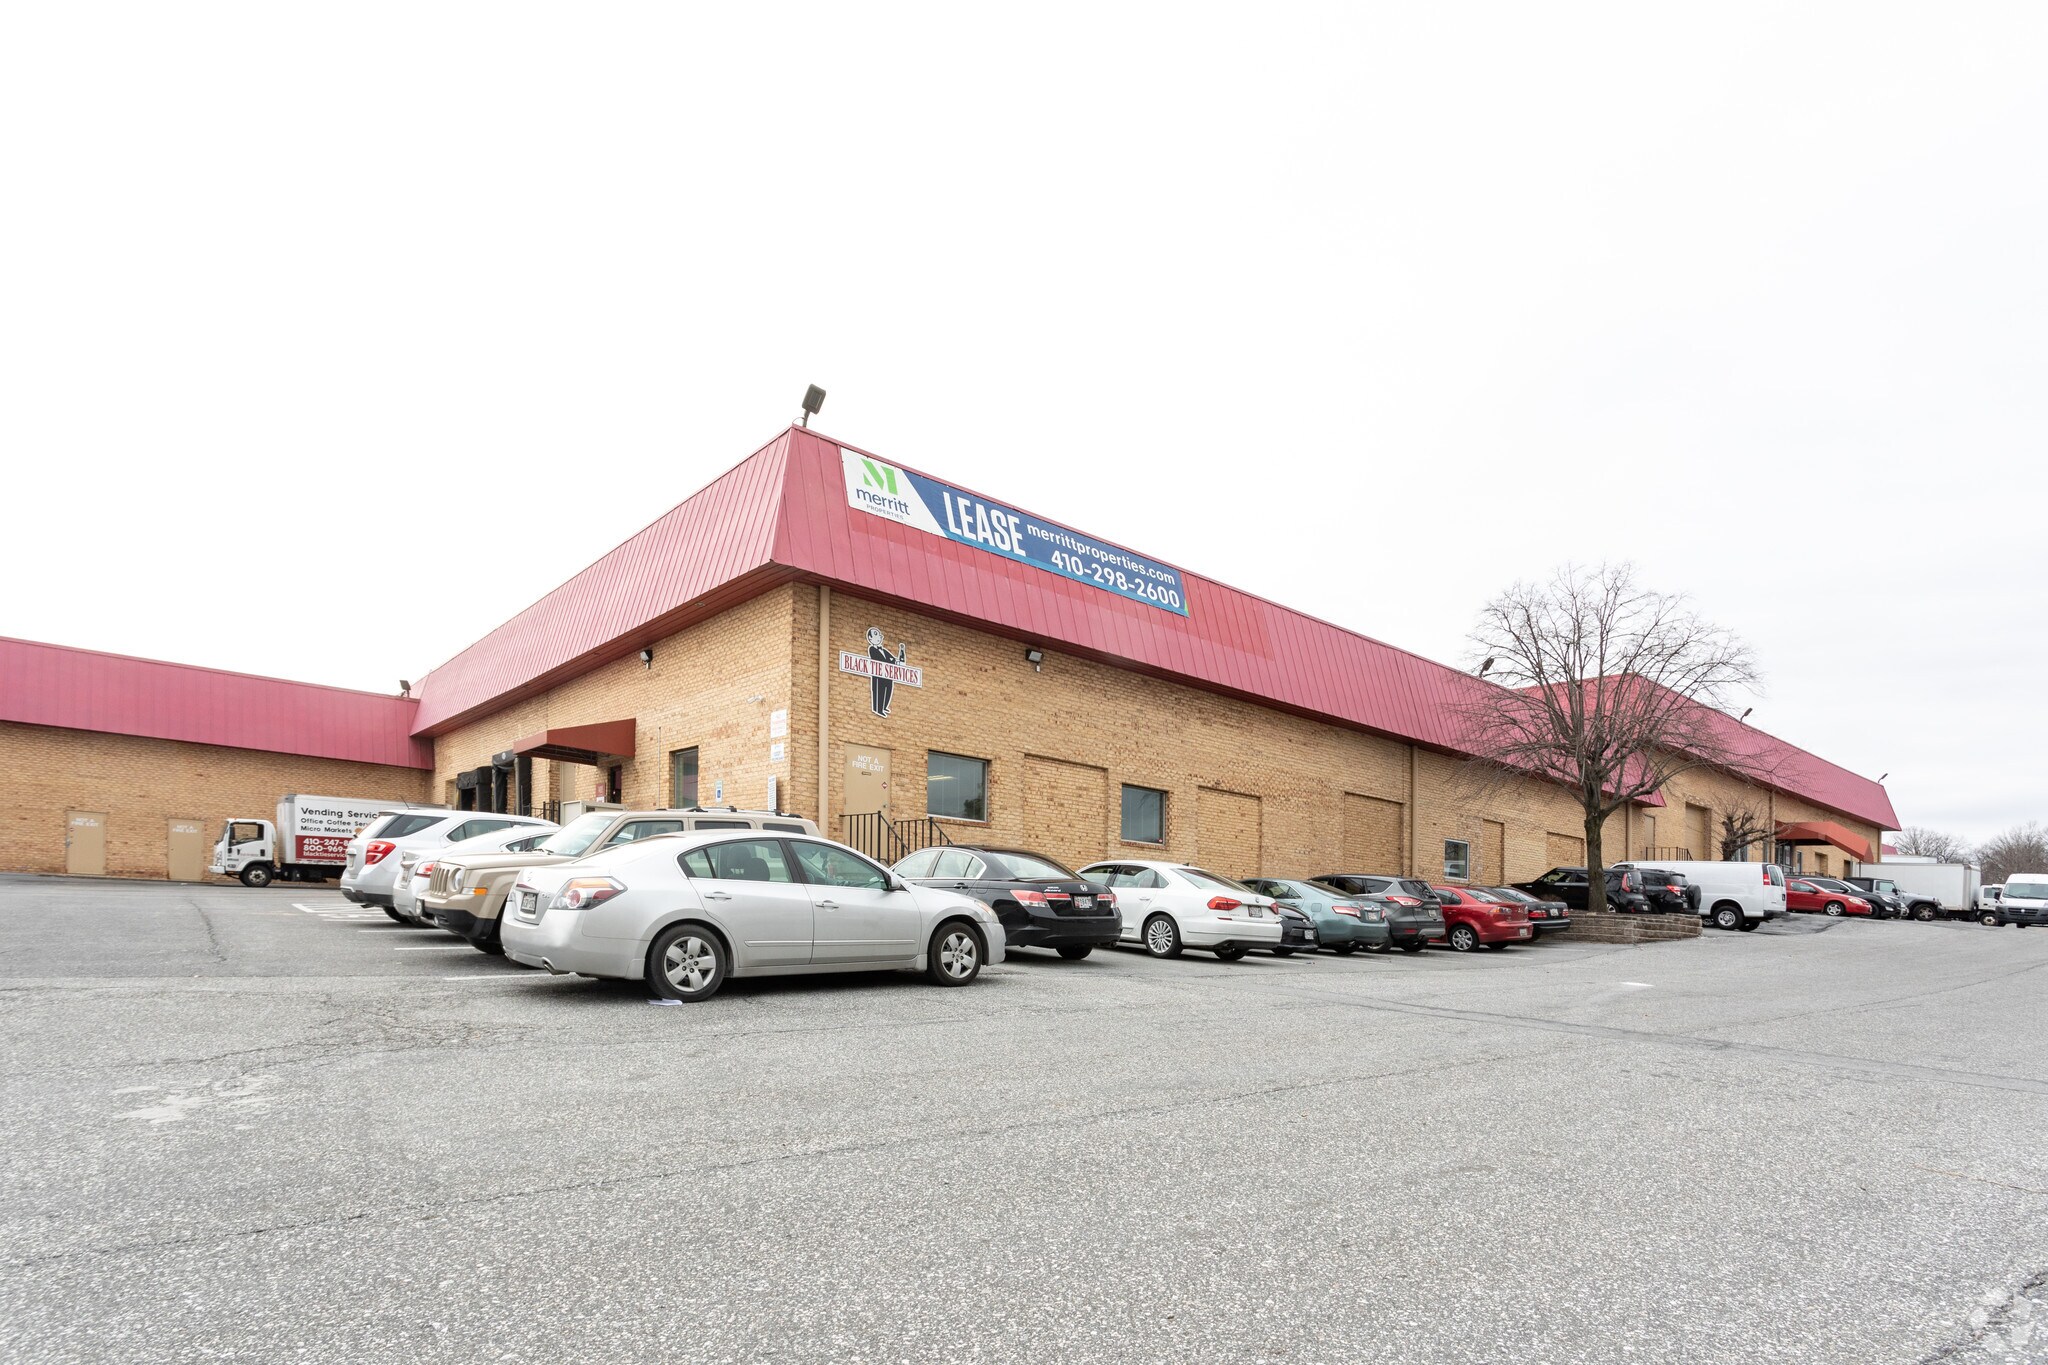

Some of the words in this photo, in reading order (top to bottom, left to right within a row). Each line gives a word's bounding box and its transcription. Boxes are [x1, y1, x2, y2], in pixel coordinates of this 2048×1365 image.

[856, 488, 910, 516] merritt
[866, 503, 904, 520] PROPERTIES
[943, 491, 1026, 557] LEASE
[1026, 523, 1176, 586] merrittproperties.com
[1051, 550, 1180, 608] 410-298-2600
[844, 655, 869, 674] BLACK
[870, 661, 883, 677] TIE
[884, 663, 918, 684] SERVICES
[852, 760, 867, 769] FIRE
[869, 763, 884, 772] EXIT
[857, 755, 872, 763] NOT
[873, 757, 879, 765] A
[301, 807, 343, 818] Vending
[347, 811, 379, 819] Servic
[326, 819, 351, 827] Coffee
